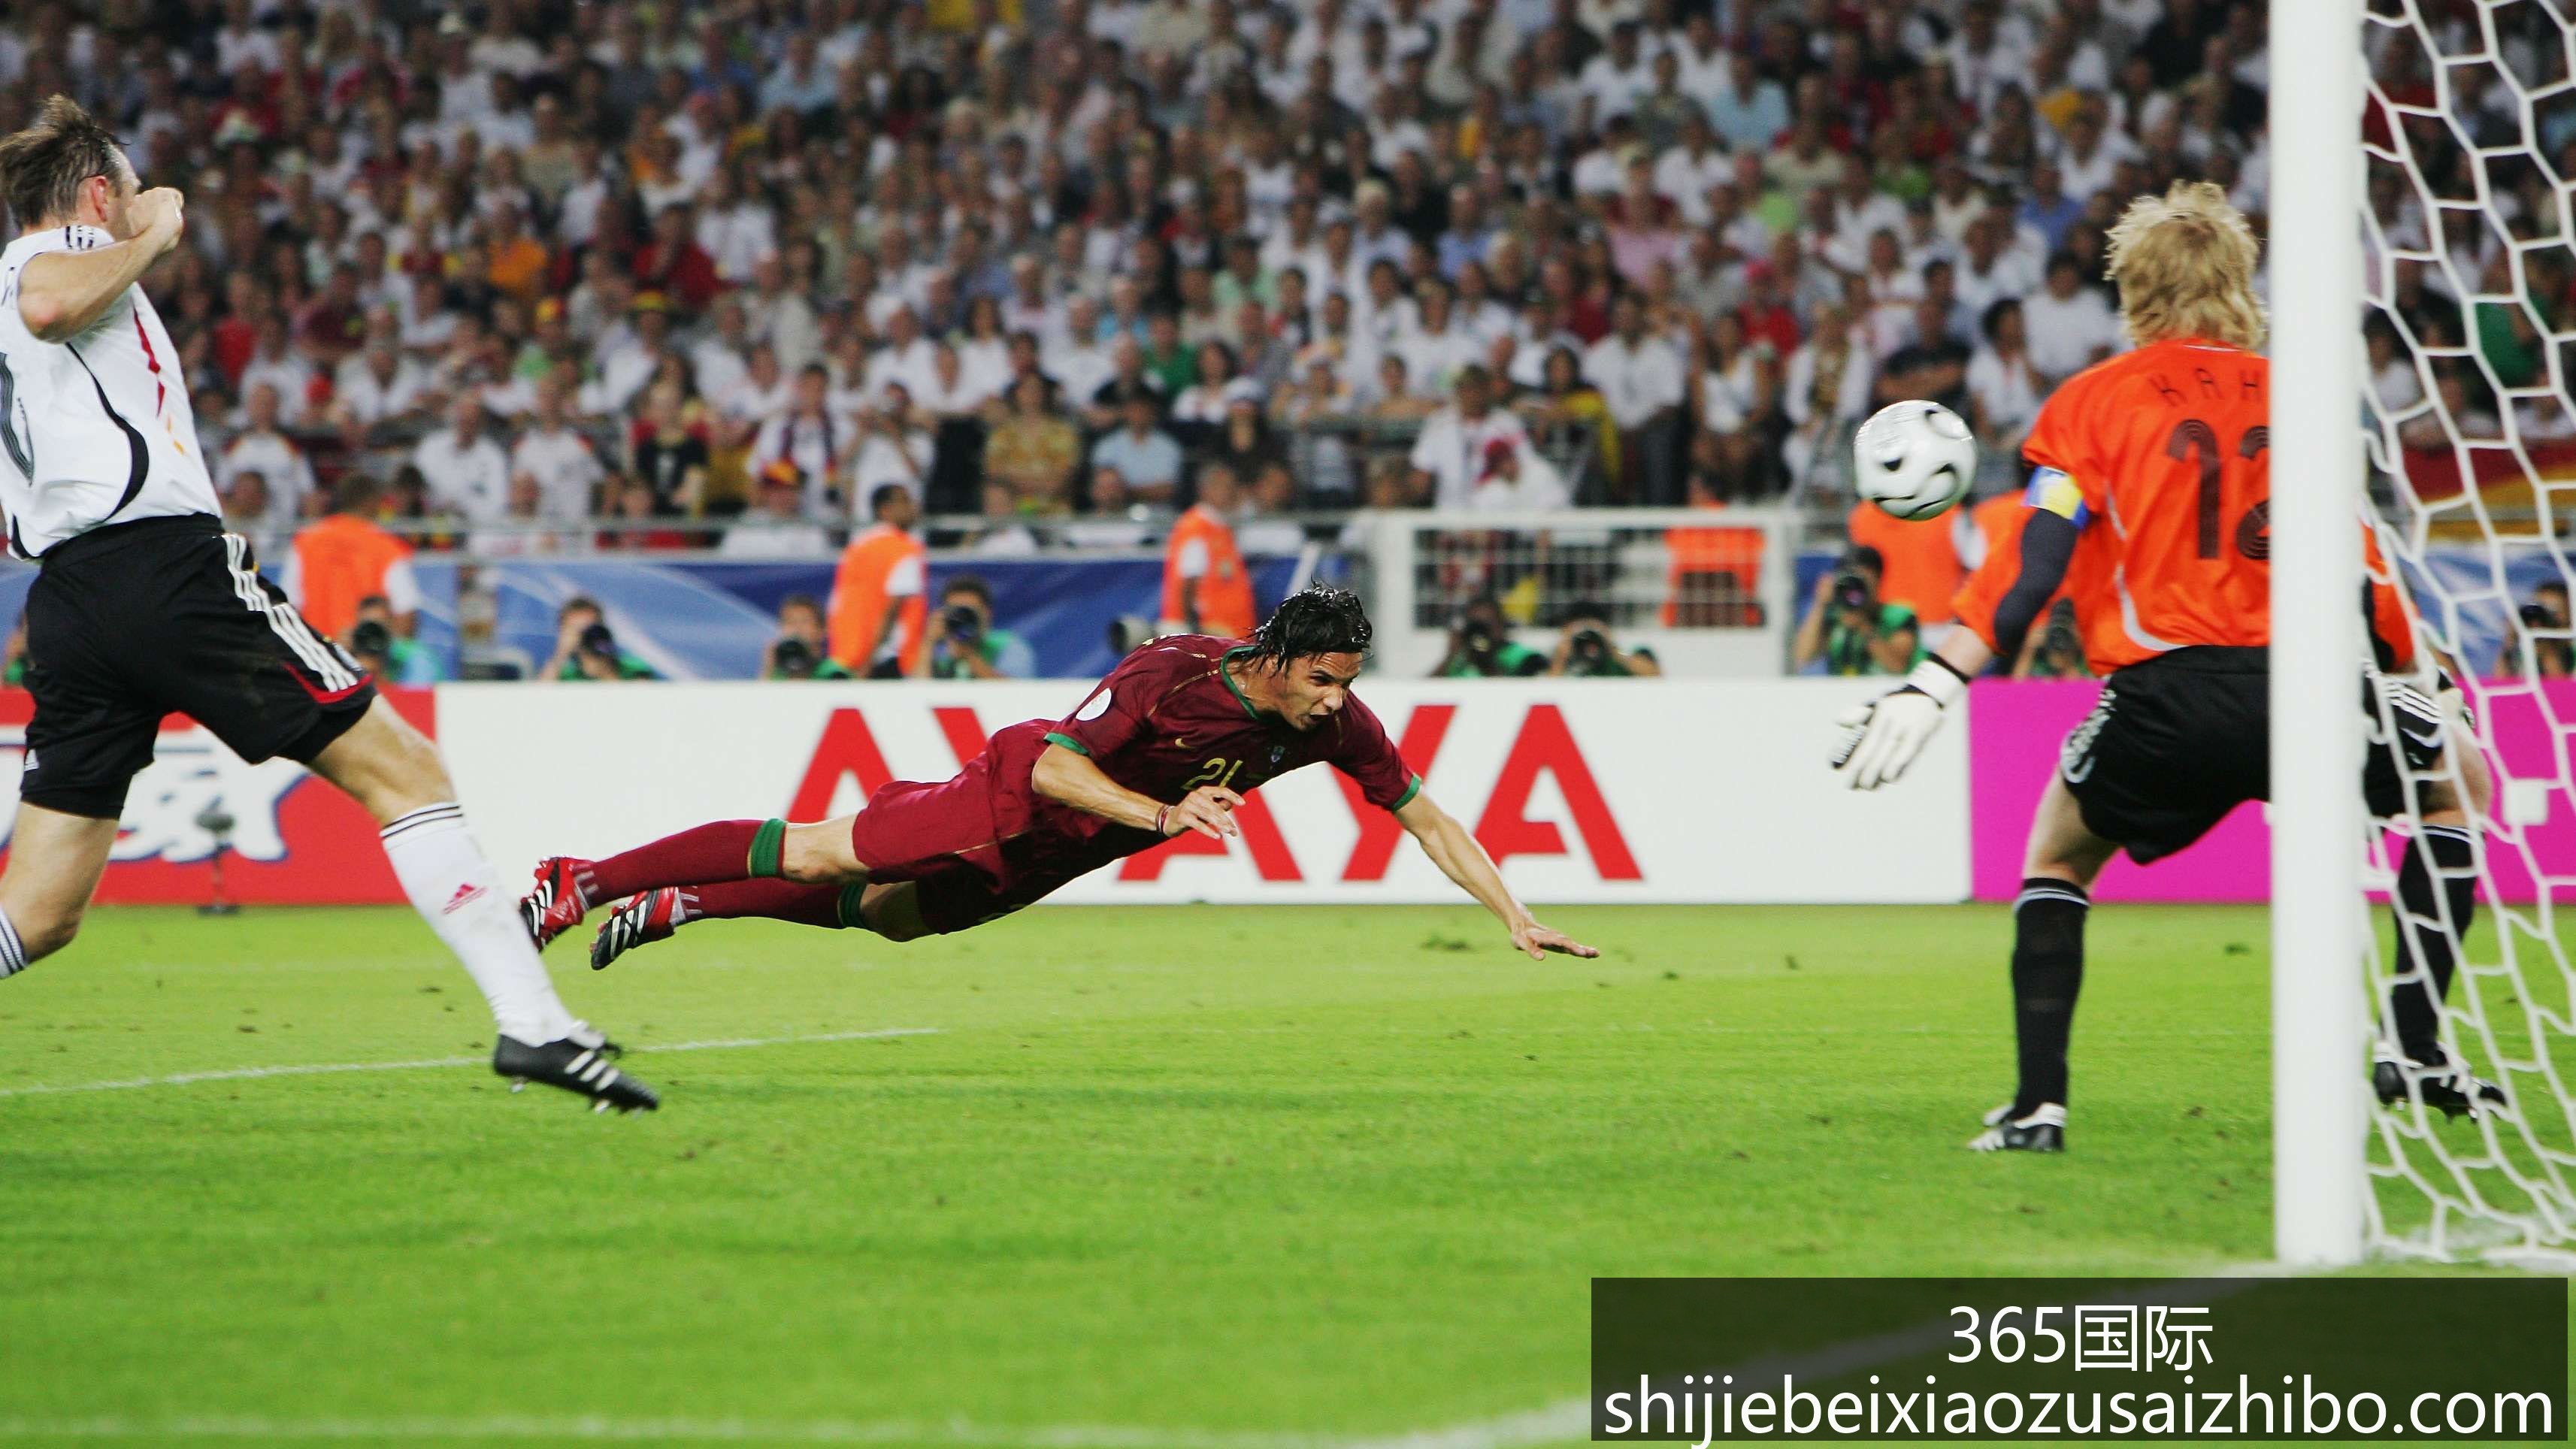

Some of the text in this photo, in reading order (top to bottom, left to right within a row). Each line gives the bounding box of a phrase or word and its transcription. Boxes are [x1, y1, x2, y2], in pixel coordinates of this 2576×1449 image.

[2148, 367, 2264, 407] KAH
[786, 705, 1644, 882] AAYA
[1180, 758, 1244, 791] 21
